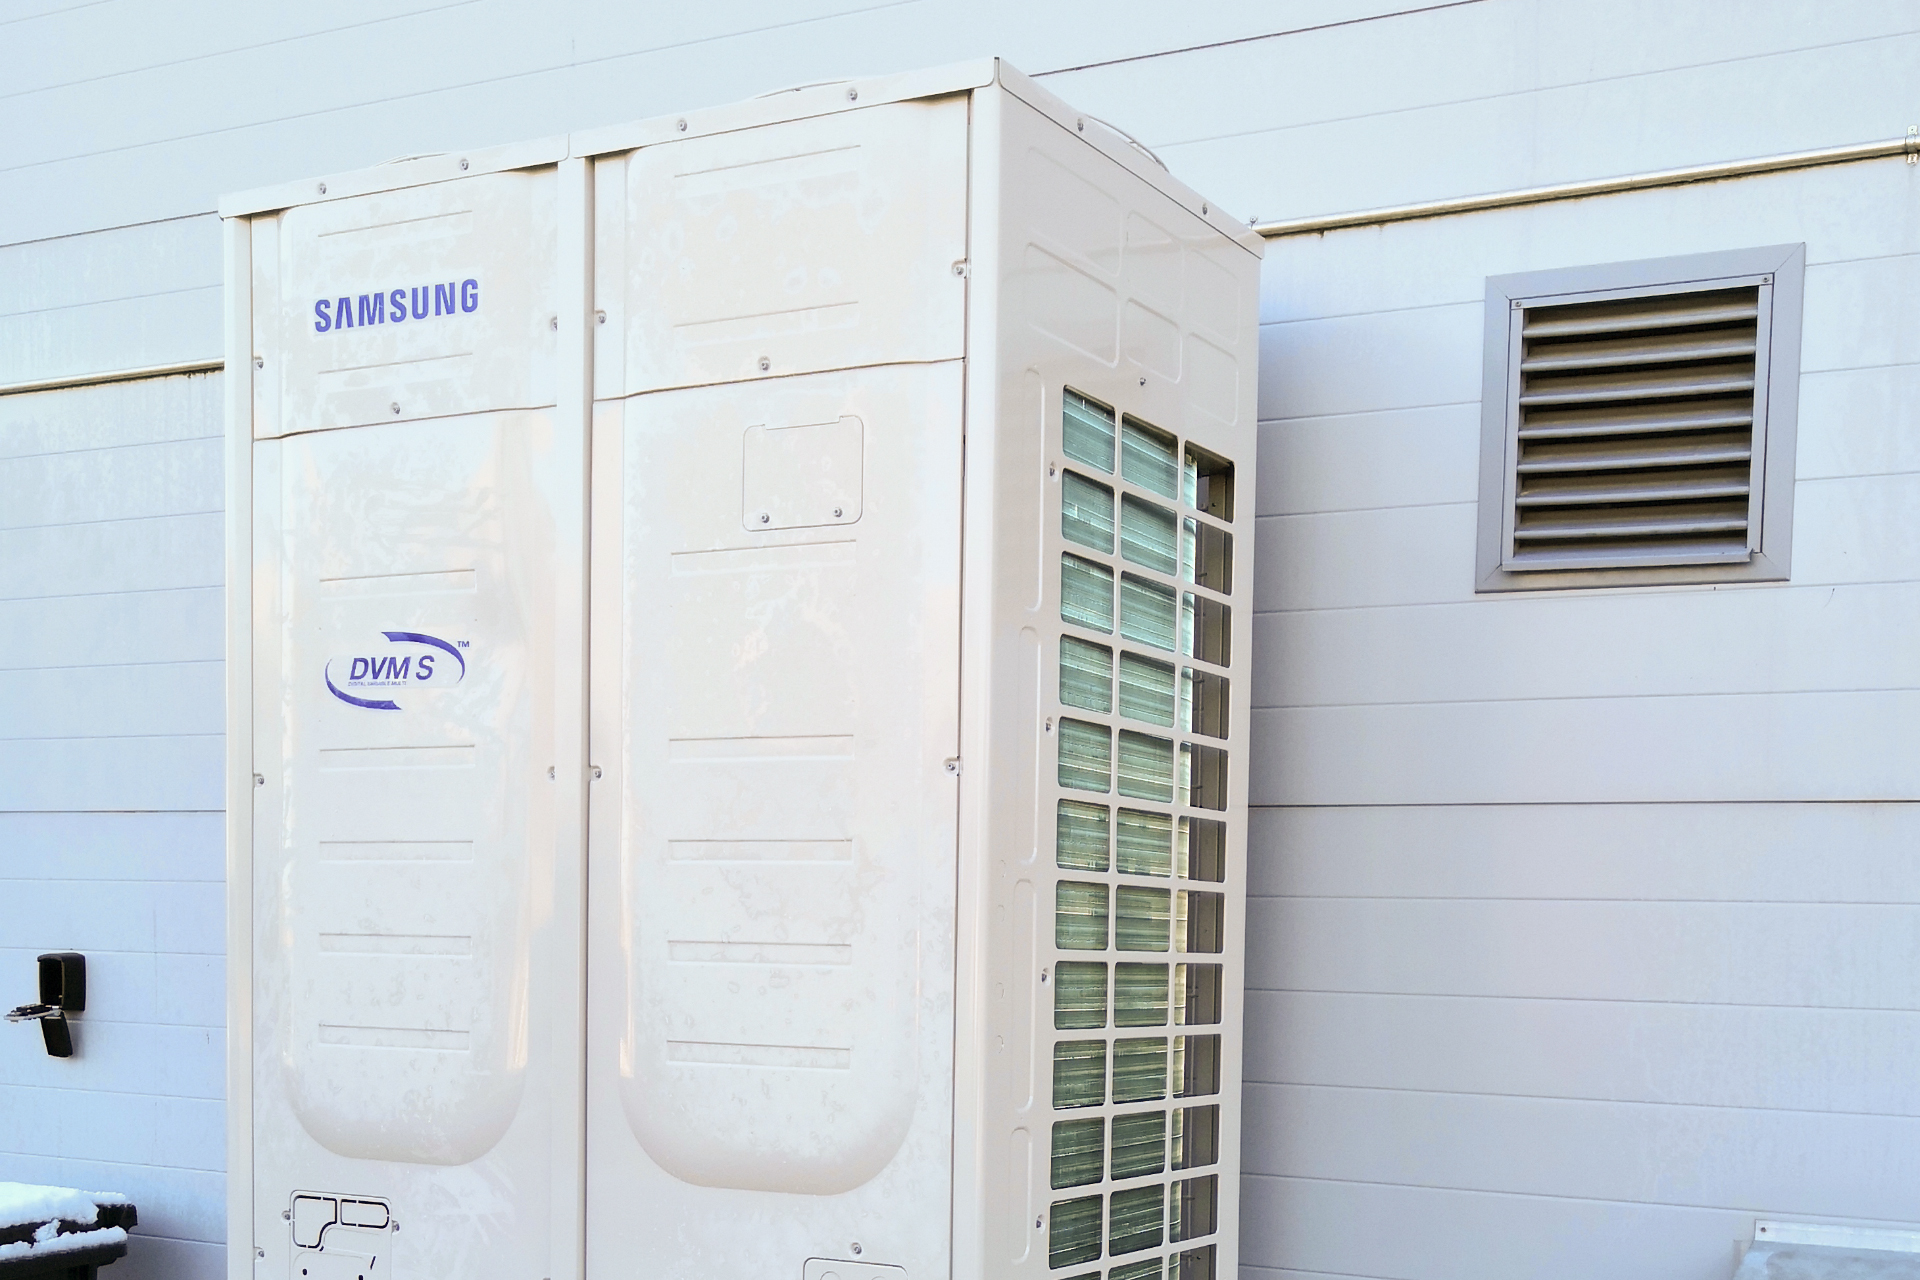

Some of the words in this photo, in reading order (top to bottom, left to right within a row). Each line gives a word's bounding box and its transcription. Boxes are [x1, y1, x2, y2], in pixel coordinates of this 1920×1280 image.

[315, 279, 478, 332] SAMSUNG
[350, 656, 411, 680] DVM
[416, 655, 435, 680] S
